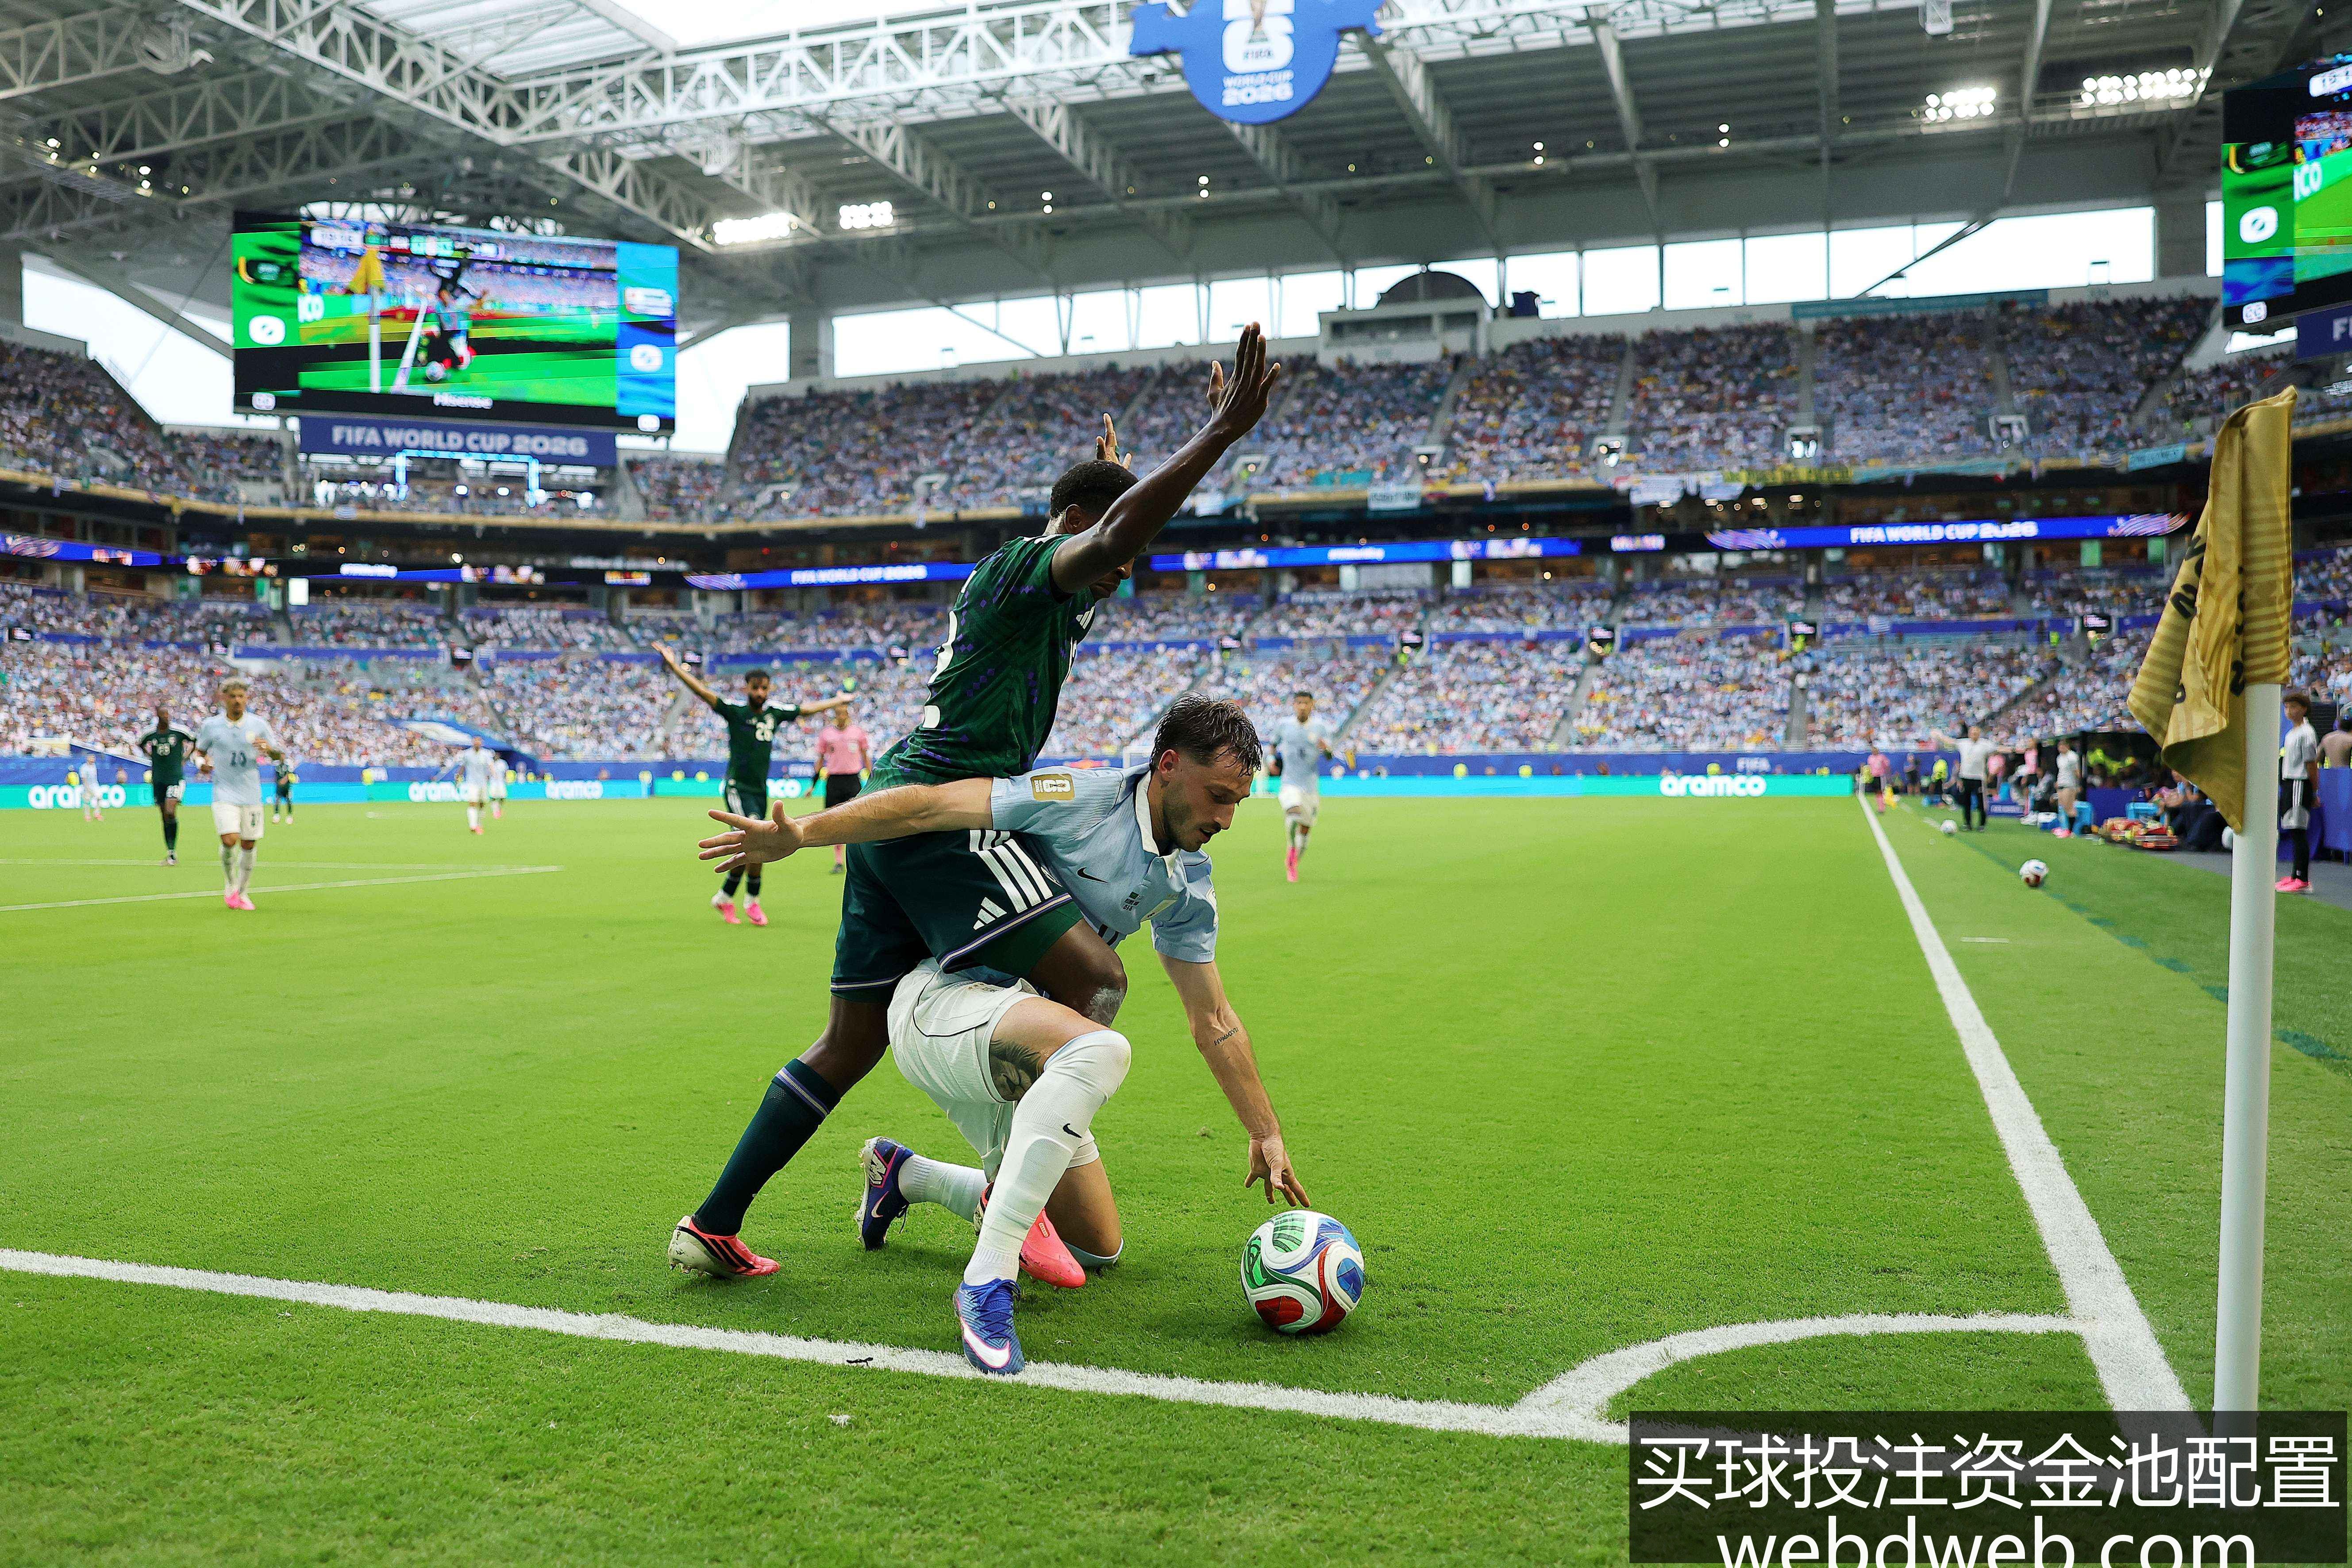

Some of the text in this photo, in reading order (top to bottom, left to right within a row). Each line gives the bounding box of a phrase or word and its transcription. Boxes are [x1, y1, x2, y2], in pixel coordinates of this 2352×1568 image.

[1221, 81, 1295, 107] 2026
[331, 424, 589, 457] FIFA WORLD CUP 2026
[1849, 527, 1885, 543] FIFA
[1885, 524, 1944, 542] WORLD
[1945, 523, 1978, 540] CUP
[1659, 775, 1767, 797] aramco
